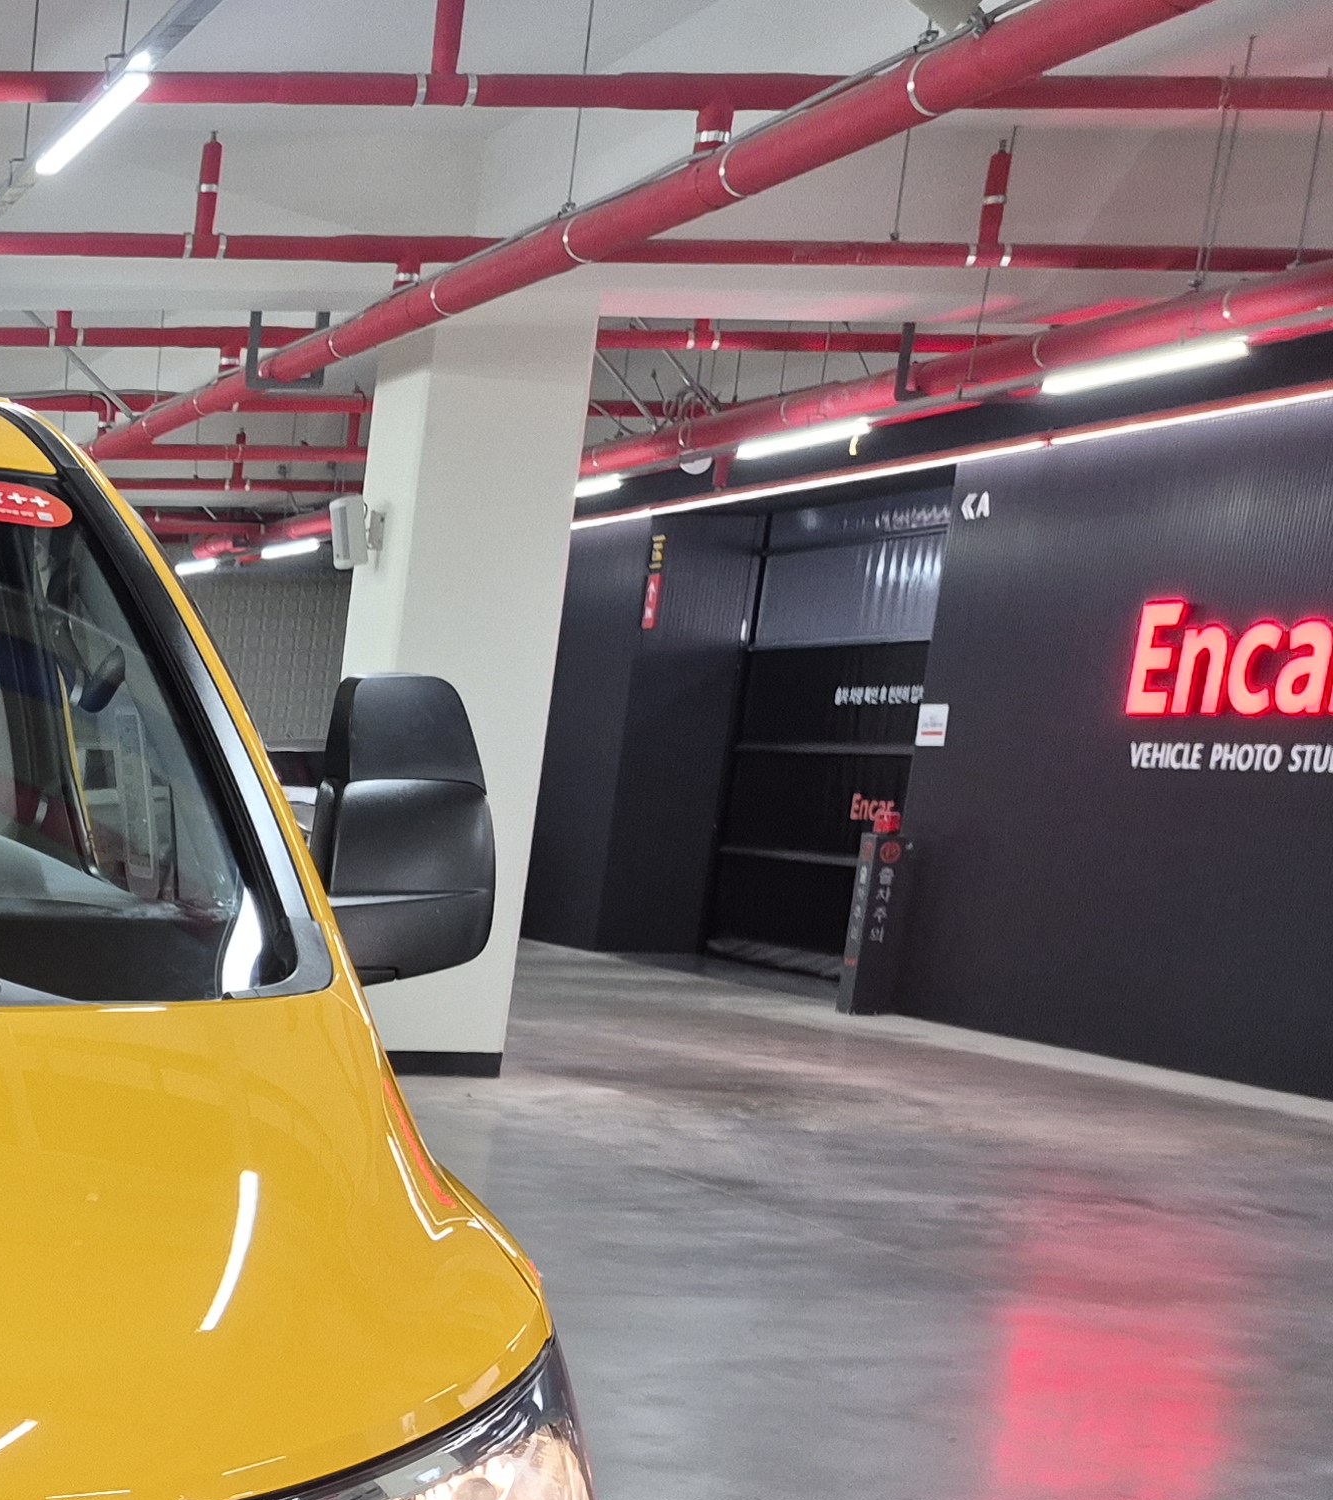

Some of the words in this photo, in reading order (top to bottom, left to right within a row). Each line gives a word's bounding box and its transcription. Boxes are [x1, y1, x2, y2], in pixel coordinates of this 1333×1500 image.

[1125, 600, 1333, 717] Enca
[1130, 740, 1205, 770] VEHICLE
[1209, 742, 1283, 772] PHOTO
